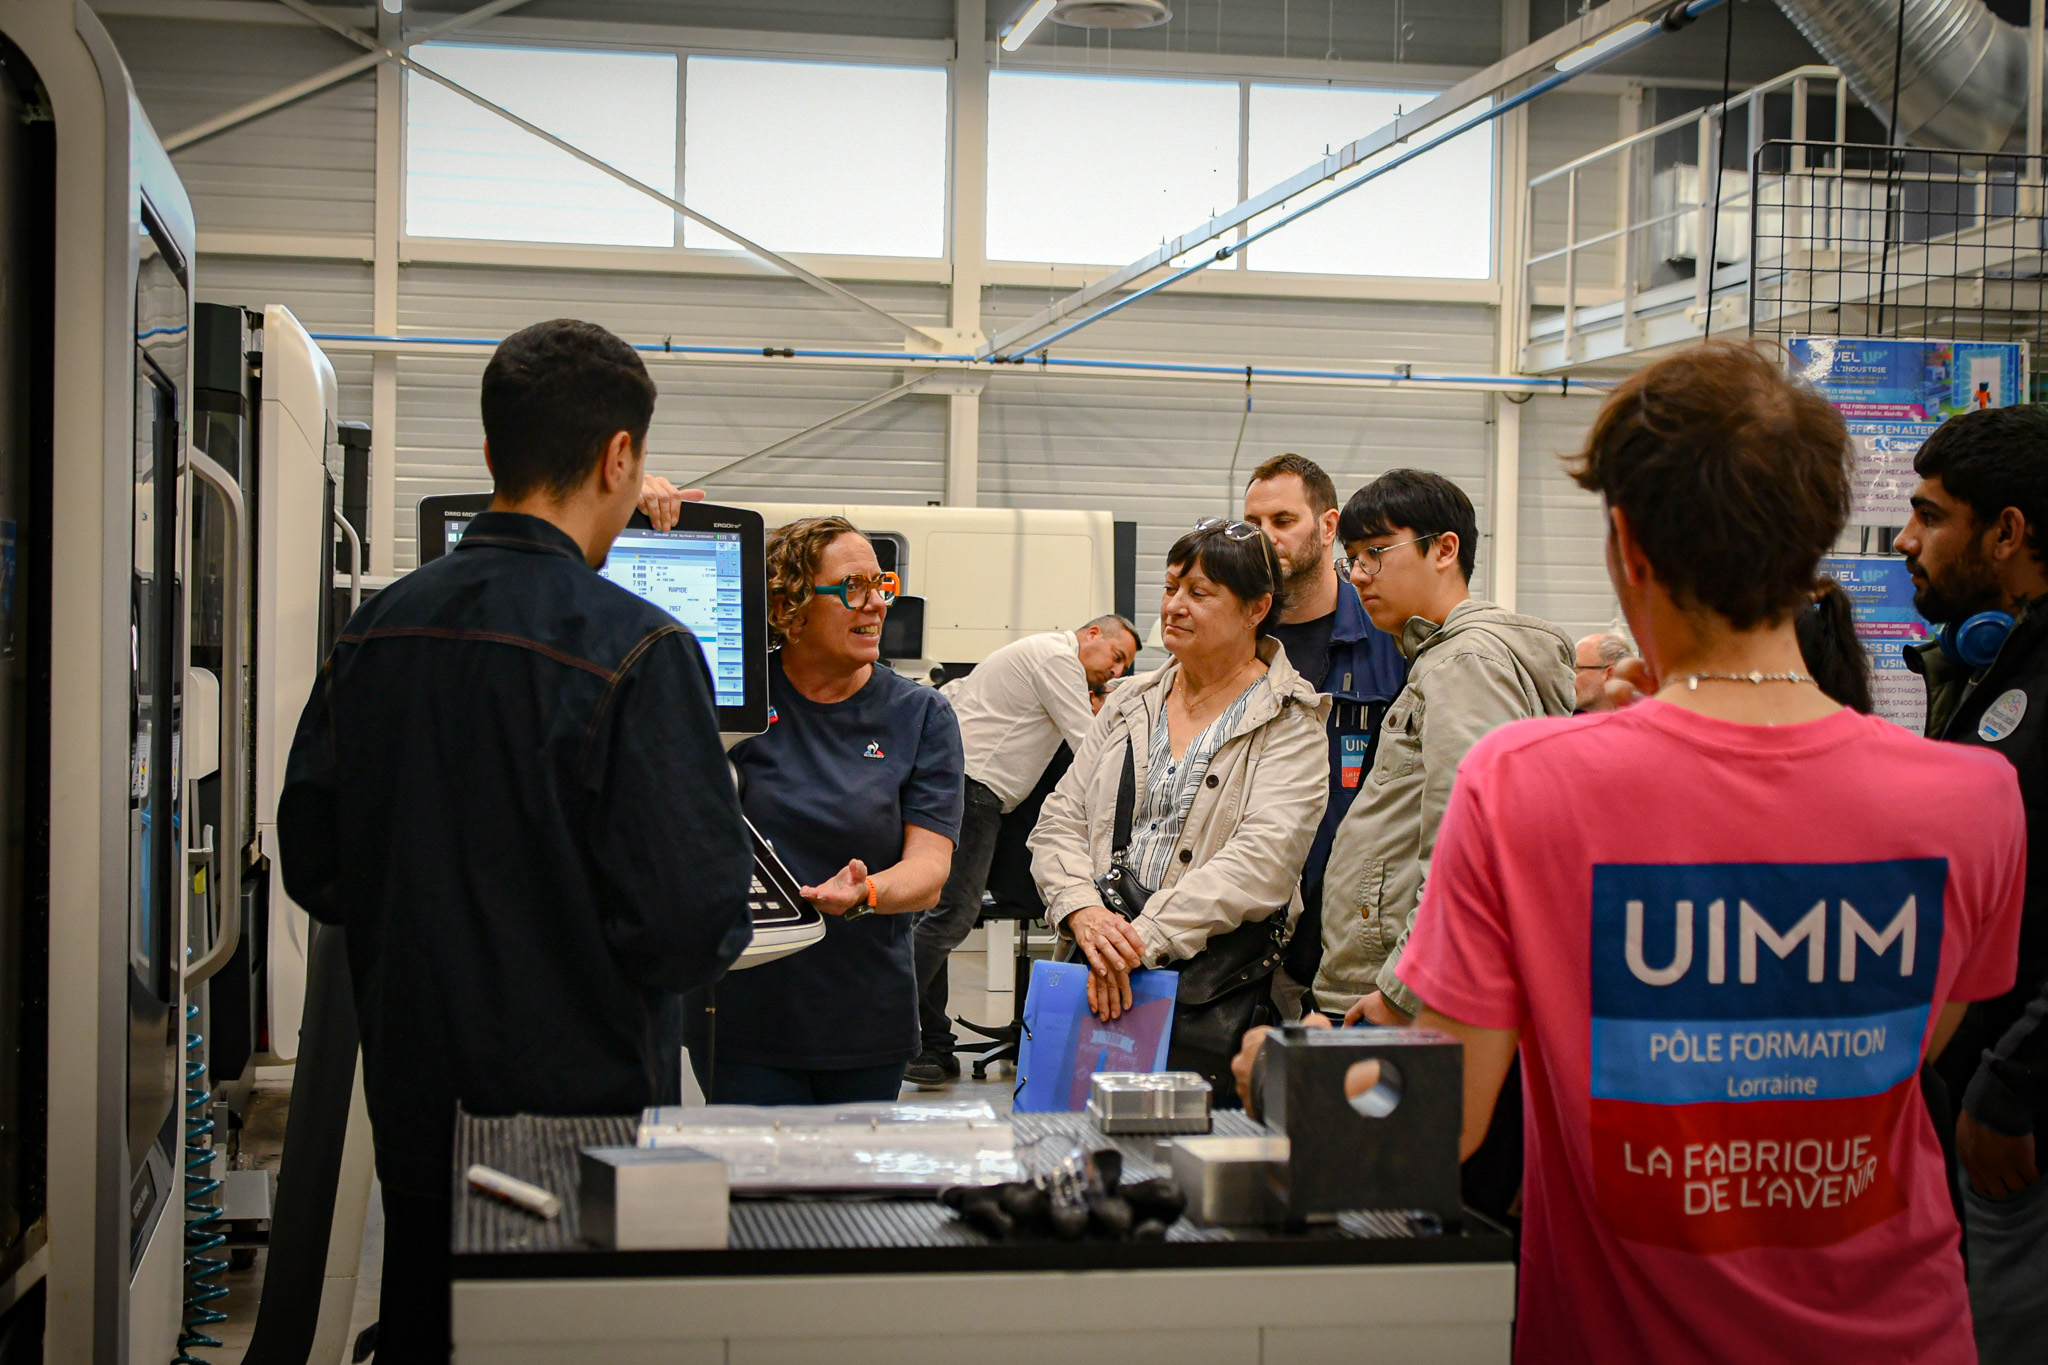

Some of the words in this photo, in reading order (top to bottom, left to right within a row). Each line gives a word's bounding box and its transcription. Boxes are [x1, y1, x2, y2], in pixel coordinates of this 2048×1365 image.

[1885, 425, 1901, 434] EN
[1885, 644, 1899, 652] EN
[1624, 894, 1916, 986] UIMM
[1650, 1029, 1723, 1062] PÔLE
[1729, 1026, 1887, 1061] FORMATION
[1727, 1075, 1817, 1098] Lorraine
[1624, 1143, 1673, 1178] LA
[1684, 1136, 1872, 1179] FABRIQUE
[1684, 1179, 1731, 1215] DE
[1740, 1156, 1878, 1209] L'AVENIR
